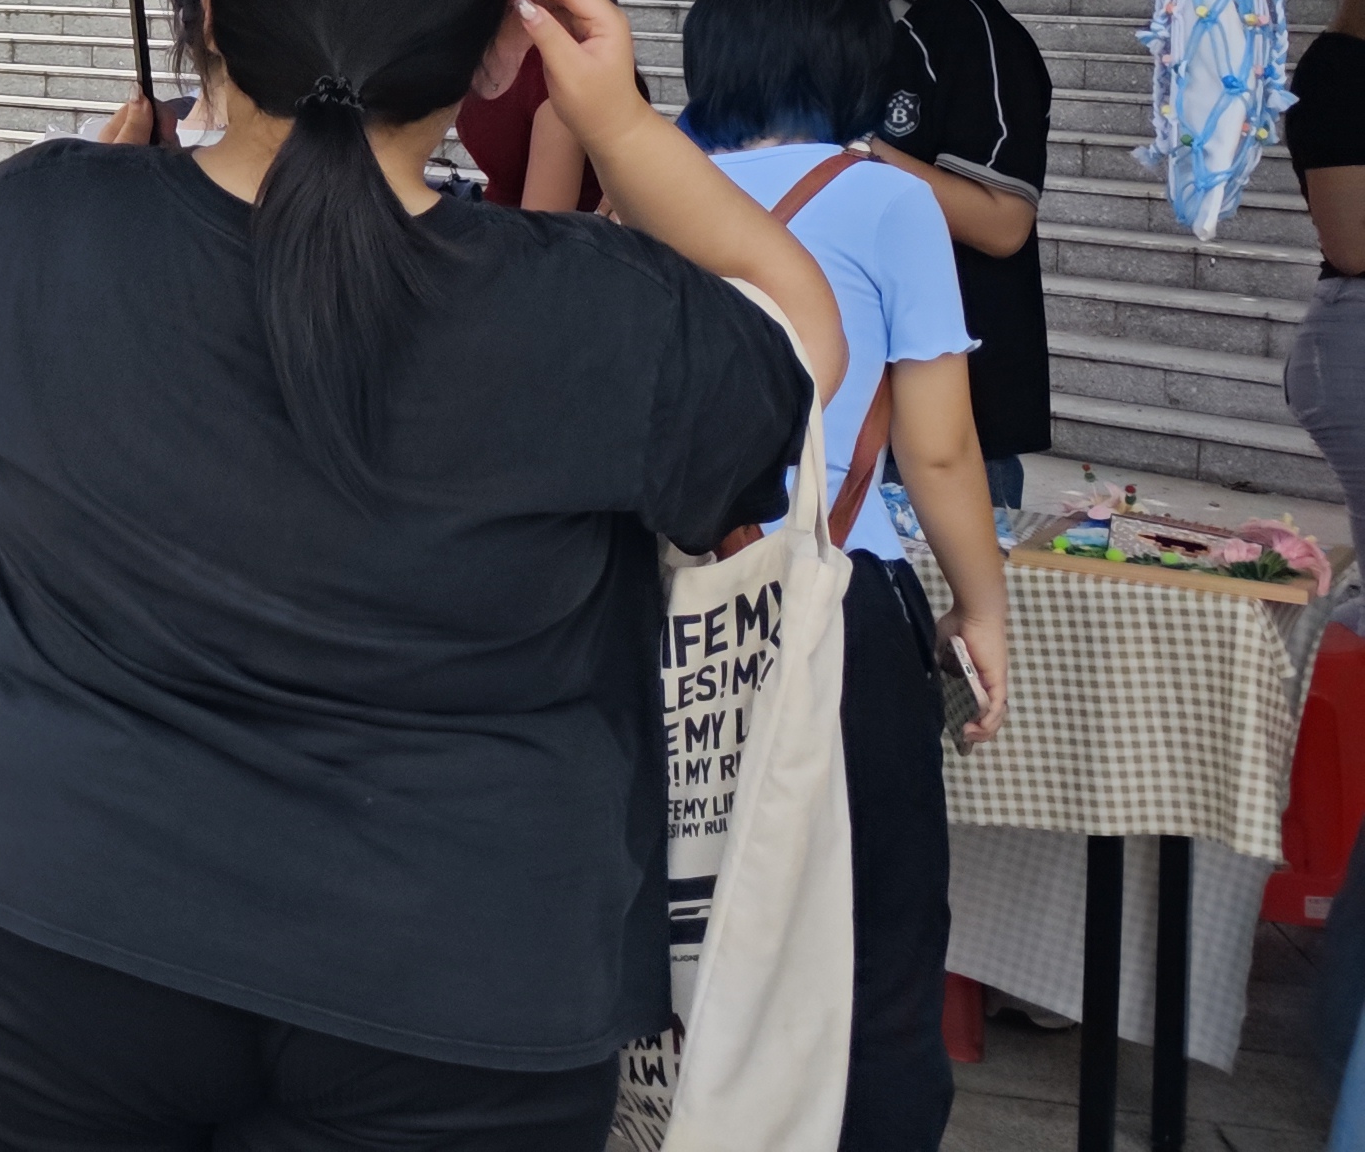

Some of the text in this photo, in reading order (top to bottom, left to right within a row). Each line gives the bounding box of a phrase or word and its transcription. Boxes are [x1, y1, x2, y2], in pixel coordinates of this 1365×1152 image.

[892, 107, 908, 123] B
[685, 709, 727, 753] MY
[686, 756, 713, 786] MY
[683, 797, 709, 820] MY
[682, 822, 701, 838] MY
